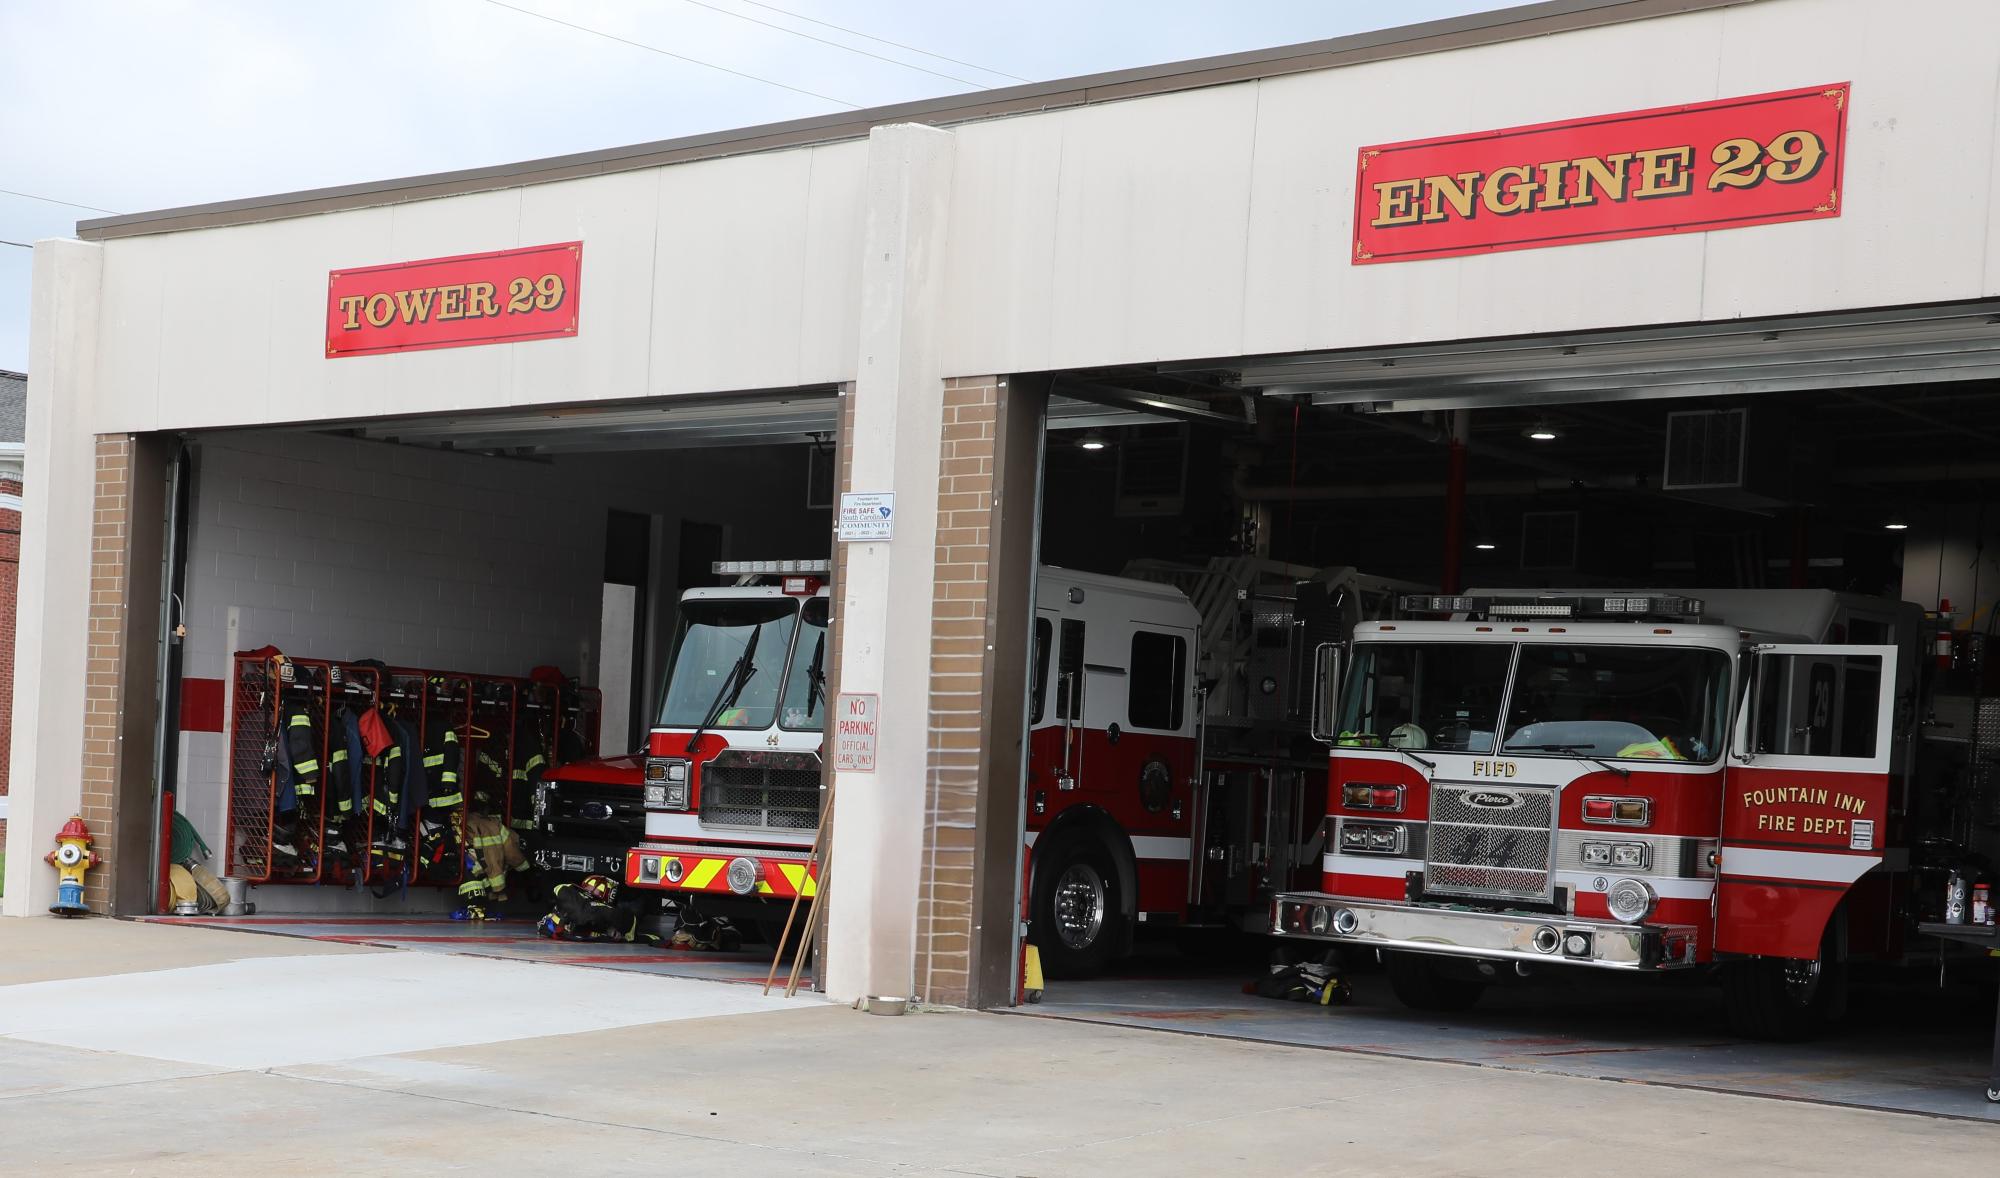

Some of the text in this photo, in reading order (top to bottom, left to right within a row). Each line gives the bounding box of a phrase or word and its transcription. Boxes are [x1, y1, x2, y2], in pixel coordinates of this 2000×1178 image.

[1370, 129, 1829, 229] ENGINE 29
[339, 273, 566, 331] TOWER 29
[850, 701, 866, 716] NO
[1814, 680, 1828, 725] 29
[839, 721, 874, 735] PARKING
[842, 740, 869, 751] OFFICIAL
[838, 753, 873, 765] CARS ONLY
[1473, 760, 1518, 778] FIFD
[1474, 793, 1509, 804] Pierce
[1743, 787, 1867, 815] FOUNTAIN INN
[1758, 815, 1848, 835] FIRE DEPT.
